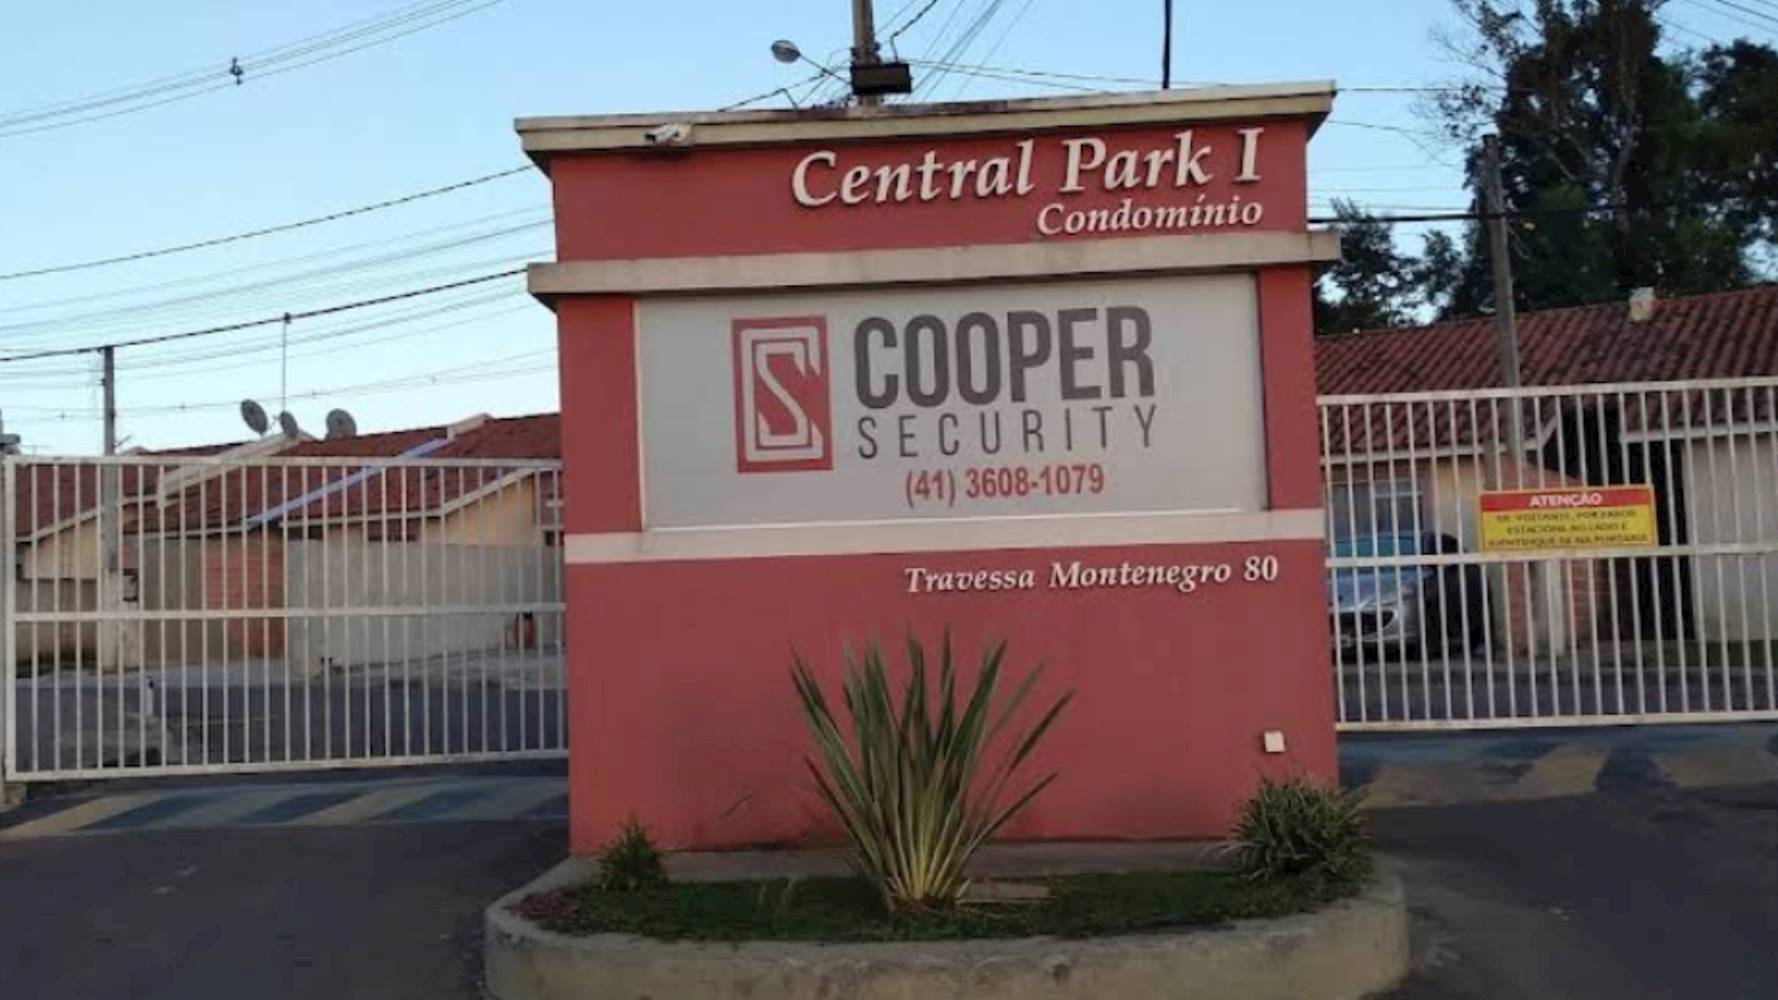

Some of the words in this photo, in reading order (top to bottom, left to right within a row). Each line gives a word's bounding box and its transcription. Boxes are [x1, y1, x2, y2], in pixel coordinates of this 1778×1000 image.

[792, 138, 1035, 207] Central
[1058, 130, 1213, 194] Park
[1234, 127, 1265, 181] I
[1036, 194, 1264, 236] Condomínio
[853, 305, 1156, 409] COOPER
[856, 404, 1158, 460] SECURITY
[904, 469, 957, 508] (41)
[965, 462, 1105, 499] 3608-1079
[1529, 492, 1603, 508] ATENÇÃO
[905, 566, 1036, 593] Travessa
[1048, 559, 1232, 592] Montenegro
[1243, 554, 1279, 582] 80
